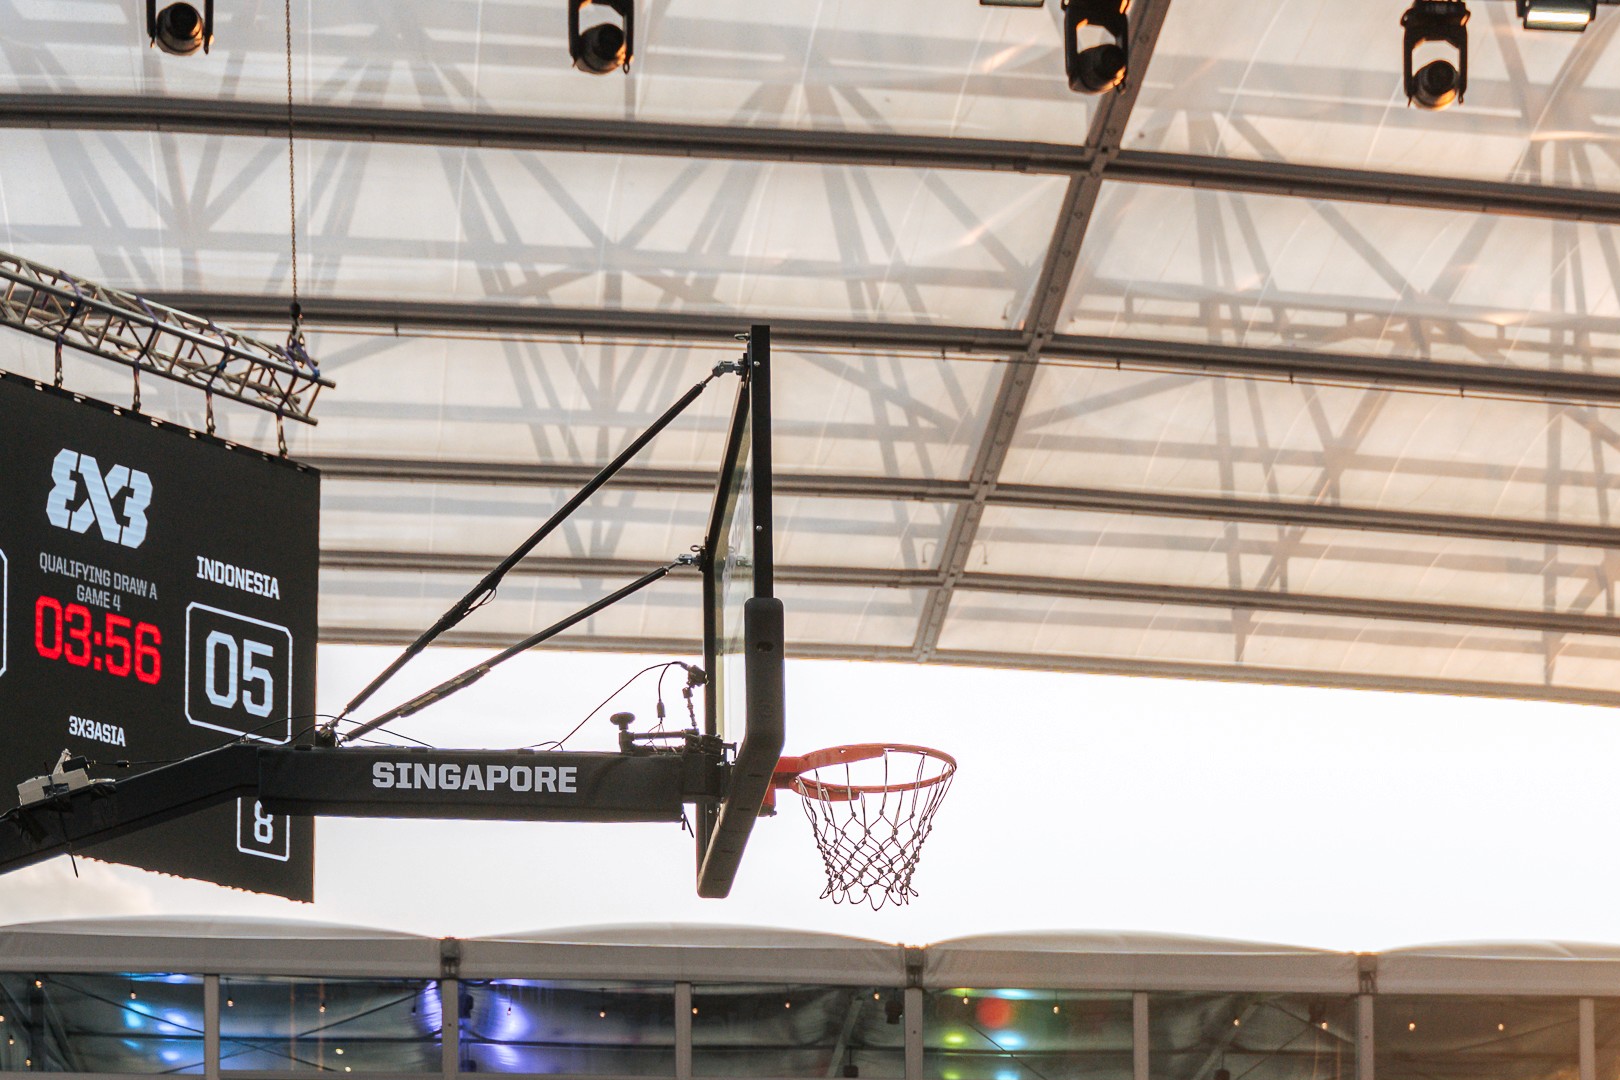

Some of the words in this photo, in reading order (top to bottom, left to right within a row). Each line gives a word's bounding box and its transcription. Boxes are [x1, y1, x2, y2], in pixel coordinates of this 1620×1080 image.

[39, 552, 111, 587] QUALIFYING
[114, 573, 148, 598] DRAW
[149, 583, 158, 600] A
[76, 584, 111, 609] GAME
[113, 594, 121, 611] 4
[196, 555, 280, 600] INDONESIA
[36, 595, 162, 685] 03:56
[205, 630, 274, 718] 05
[69, 715, 126, 747] 3X3ASIA
[373, 761, 577, 793] SINGAPORE
